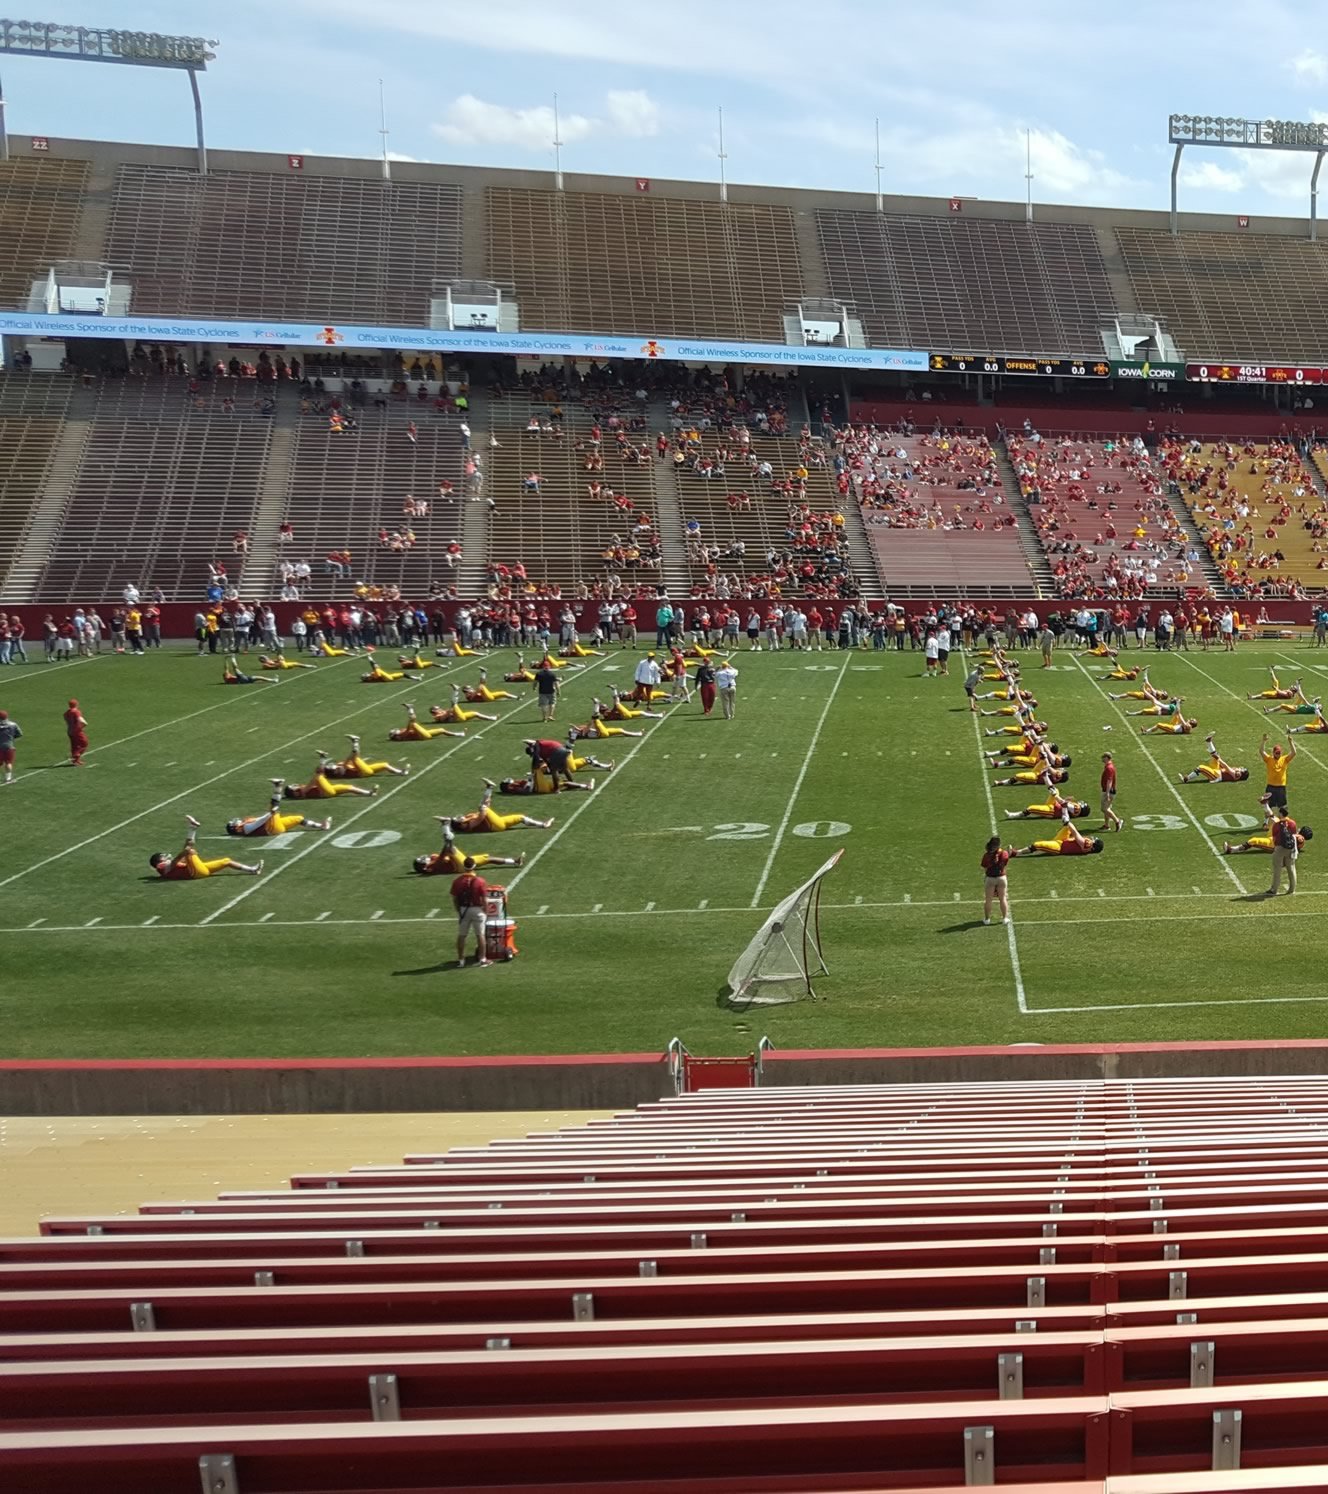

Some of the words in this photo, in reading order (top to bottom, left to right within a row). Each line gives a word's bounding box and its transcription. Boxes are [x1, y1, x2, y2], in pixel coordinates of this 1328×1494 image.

[32, 142, 48, 150] ZZ
[0, 319, 32, 329] Official
[35, 320, 75, 330] Wireless
[77, 322, 116, 334] Sponsor
[118, 324, 130, 332] of
[131, 324, 147, 333] the
[150, 326, 170, 334] Iowa
[172, 326, 196, 335] State
[198, 328, 240, 338] Cyclones
[358, 334, 388, 342] Official
[390, 335, 425, 344] Wireless
[426, 336, 462, 347] Sponsor
[464, 337, 473, 346] of
[474, 338, 488, 346] the
[491, 339, 510, 348] Iowa
[512, 340, 533, 348] State
[534, 340, 571, 351] Cyclones
[678, 346, 705, 356] Official
[707, 348, 738, 357] Wireless
[740, 350, 771, 360] Sponsor
[798, 353, 816, 361] Iowa
[817, 354, 836, 362] State
[837, 354, 872, 364] Cyclones
[984, 363, 998, 371] 0.0
[1072, 367, 1085, 375] 0.0
[1200, 367, 1207, 377] 0
[1239, 366, 1266, 376] 40:41
[1296, 370, 1303, 380] 0
[1131, 813, 1259, 830] 30
[704, 820, 853, 840] 20
[247, 830, 403, 850] 10
